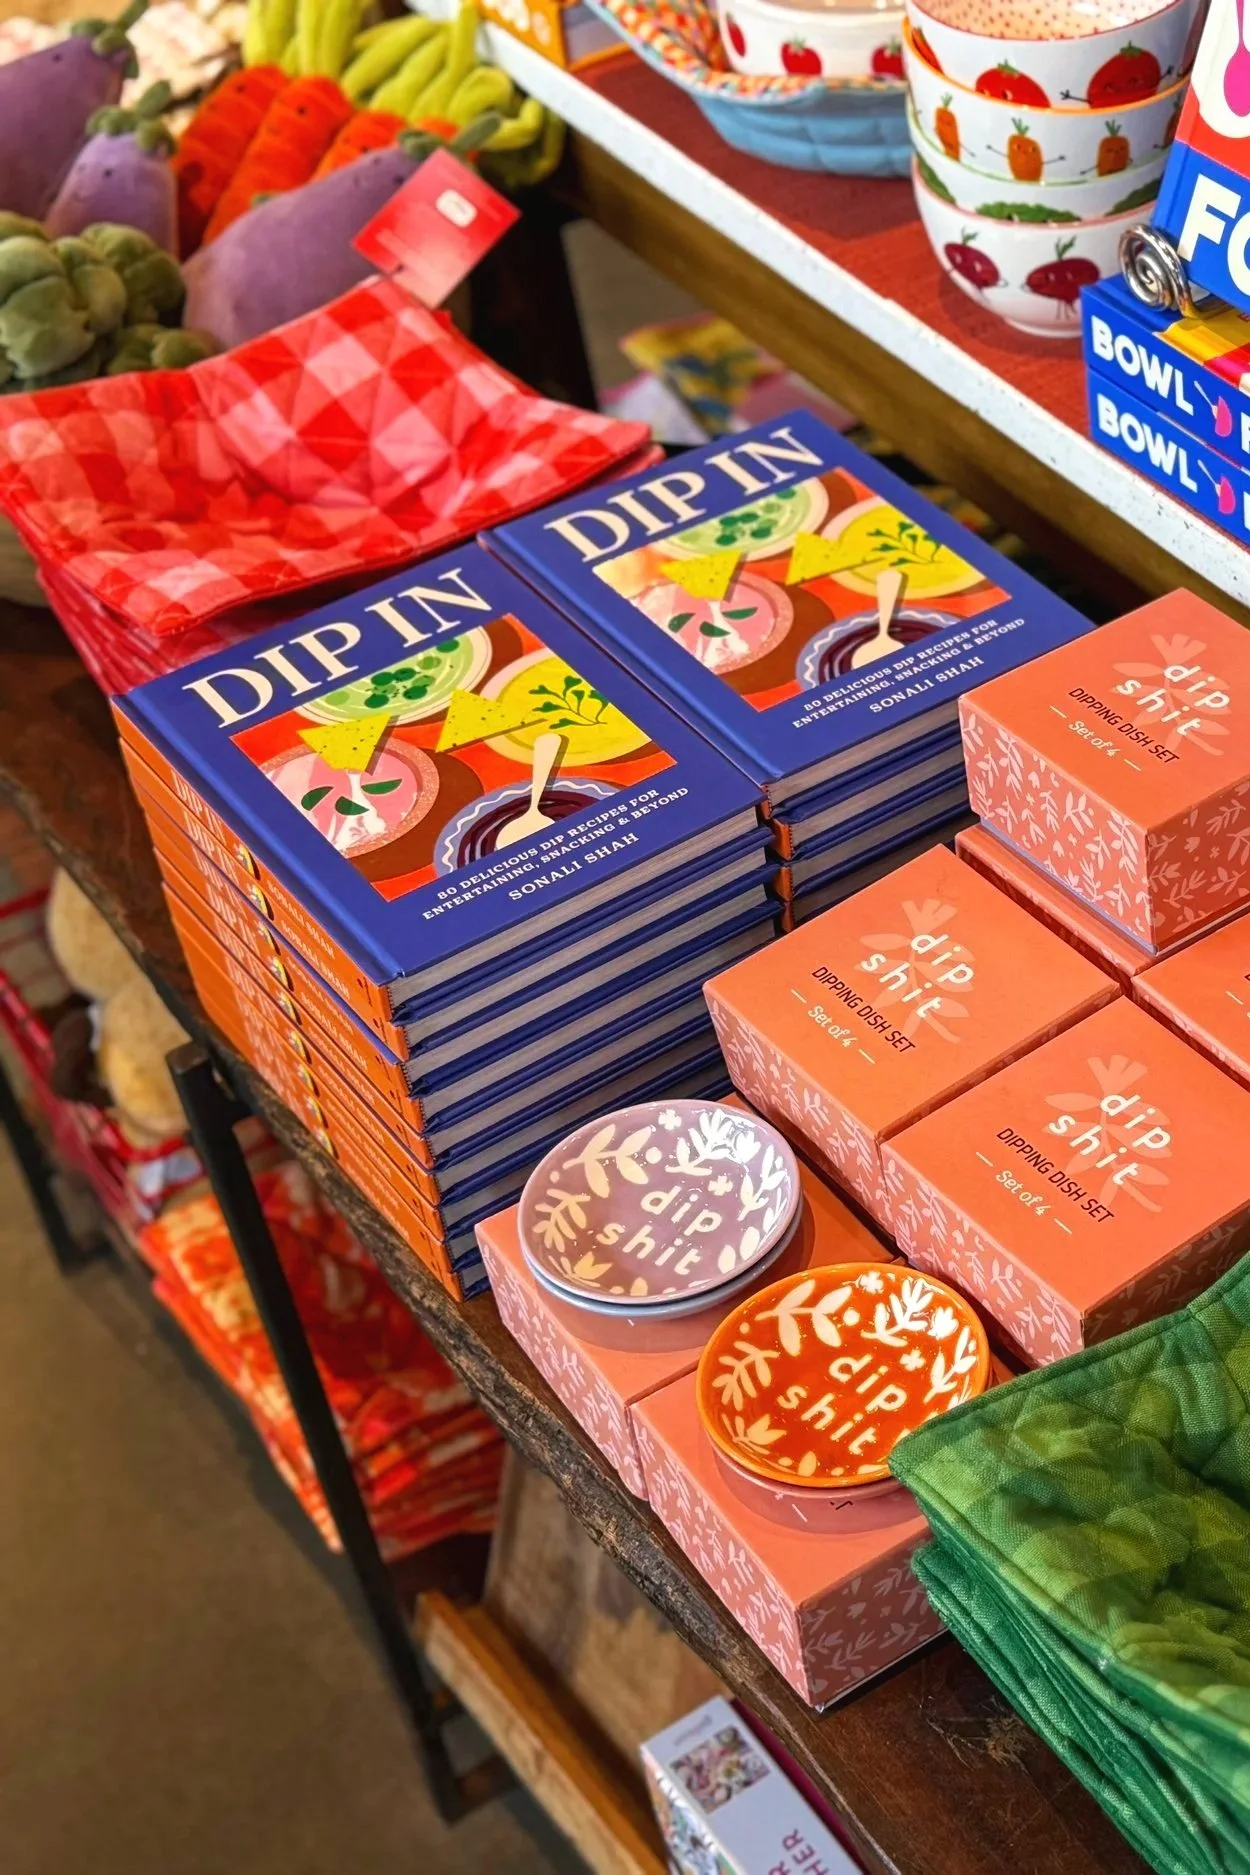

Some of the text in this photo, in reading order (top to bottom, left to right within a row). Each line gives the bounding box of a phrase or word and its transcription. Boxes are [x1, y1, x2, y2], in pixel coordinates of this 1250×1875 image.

[1091, 316, 1193, 415] BOWL
[1097, 393, 1198, 493] BOWL
[543, 426, 824, 562] DIP IN
[182, 568, 492, 728] DIP IN
[792, 681, 895, 729] ENTERTAINING,
[895, 648, 962, 681] SNACKING
[974, 618, 1025, 645] BEYOND
[804, 619, 998, 711] 80 DELICIOUS DIP RECIPES FOR
[869, 656, 984, 713] SONALI SHAH
[1115, 679, 1201, 736] shit
[1163, 664, 1230, 708] dip
[1068, 687, 1180, 764] DIPPING DISH SET
[1068, 720, 1120, 757] Set of 4
[422, 787, 689, 920] ENTERTAINING, SNACKING & BEYOND
[437, 789, 660, 900] 80 DELICIOUS DIP RECIPES FOR
[508, 833, 639, 900] SONALI SHAH
[861, 953, 942, 1018] shit
[910, 934, 974, 984] dip
[807, 1006, 858, 1048] Set of 4
[812, 966, 916, 1053] DIPPING DISH SET
[1048, 1114, 1139, 1185] shit
[1100, 1094, 1171, 1149] dip
[995, 1170, 1052, 1216] Set of 4
[996, 1128, 1115, 1223] DIPPING DISH SET
[640, 1185, 722, 1236] dip
[596, 1222, 701, 1275] shit
[828, 1354, 907, 1412] dip
[776, 1385, 877, 1456] shit
